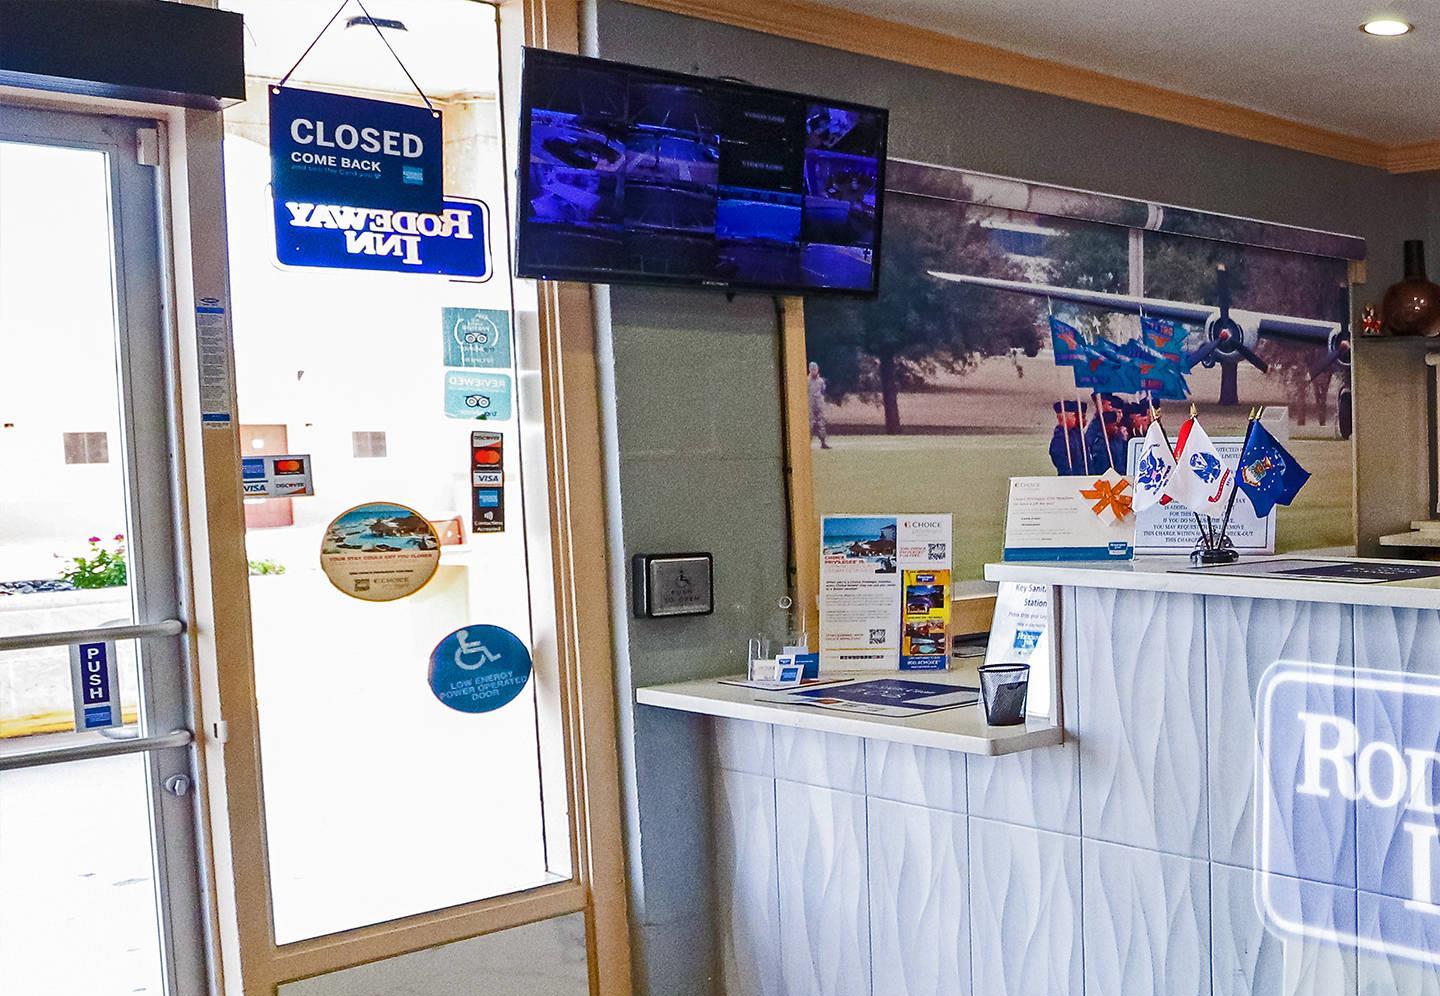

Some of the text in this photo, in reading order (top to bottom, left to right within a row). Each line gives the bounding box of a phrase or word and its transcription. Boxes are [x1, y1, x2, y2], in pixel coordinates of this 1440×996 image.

[290, 118, 424, 158] CLOSED
[290, 151, 337, 167] COME
[341, 156, 382, 173] BACK
[243, 483, 267, 492] VISA
[478, 474, 499, 482] VISA
[1024, 598, 1048, 608] Station
[87, 647, 103, 699] PUSH
[450, 670, 513, 690] LOW ENERGY
[440, 675, 528, 700] POWER OPERATED
[471, 689, 500, 701] DOOR
